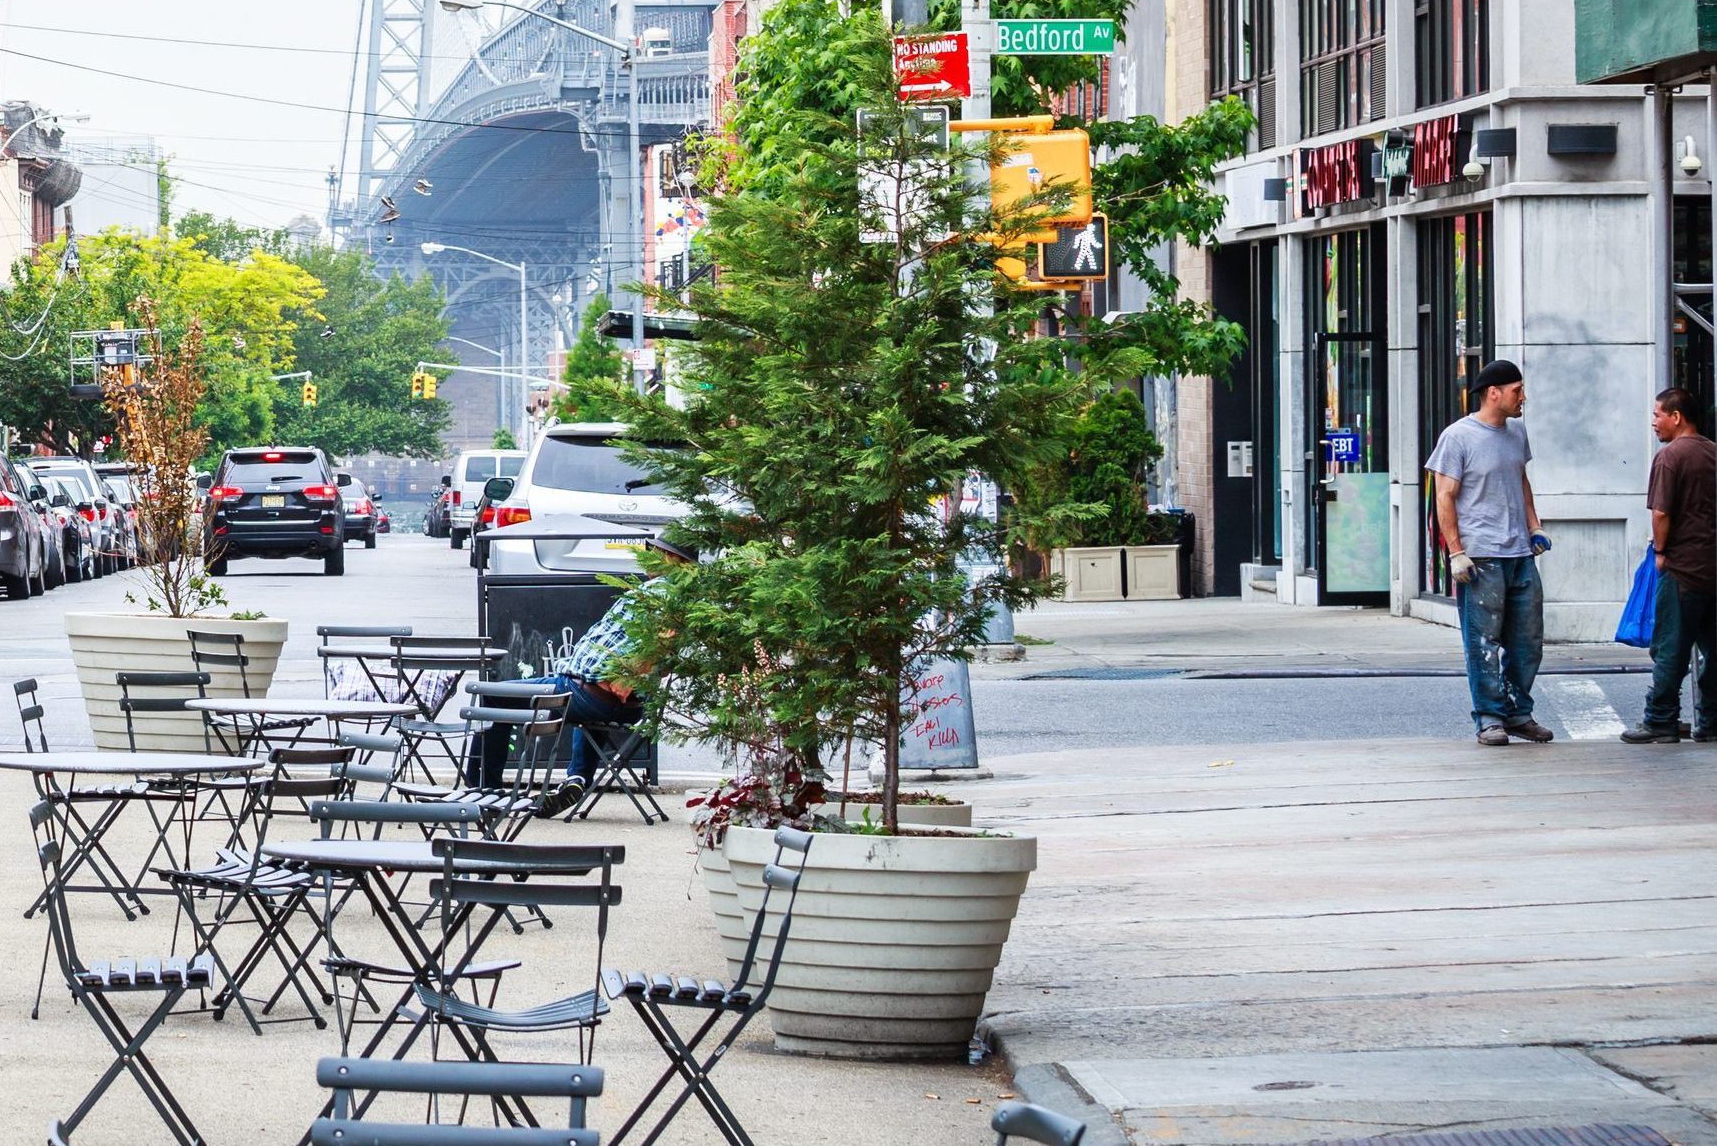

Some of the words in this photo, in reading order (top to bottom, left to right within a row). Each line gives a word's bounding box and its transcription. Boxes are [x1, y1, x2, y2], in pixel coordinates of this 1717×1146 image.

[998, 23, 1085, 51] Bedford
[1093, 25, 1110, 39] Av
[896, 43, 911, 56] NO
[912, 39, 958, 55] STANDING
[1332, 438, 1354, 452] EBT
